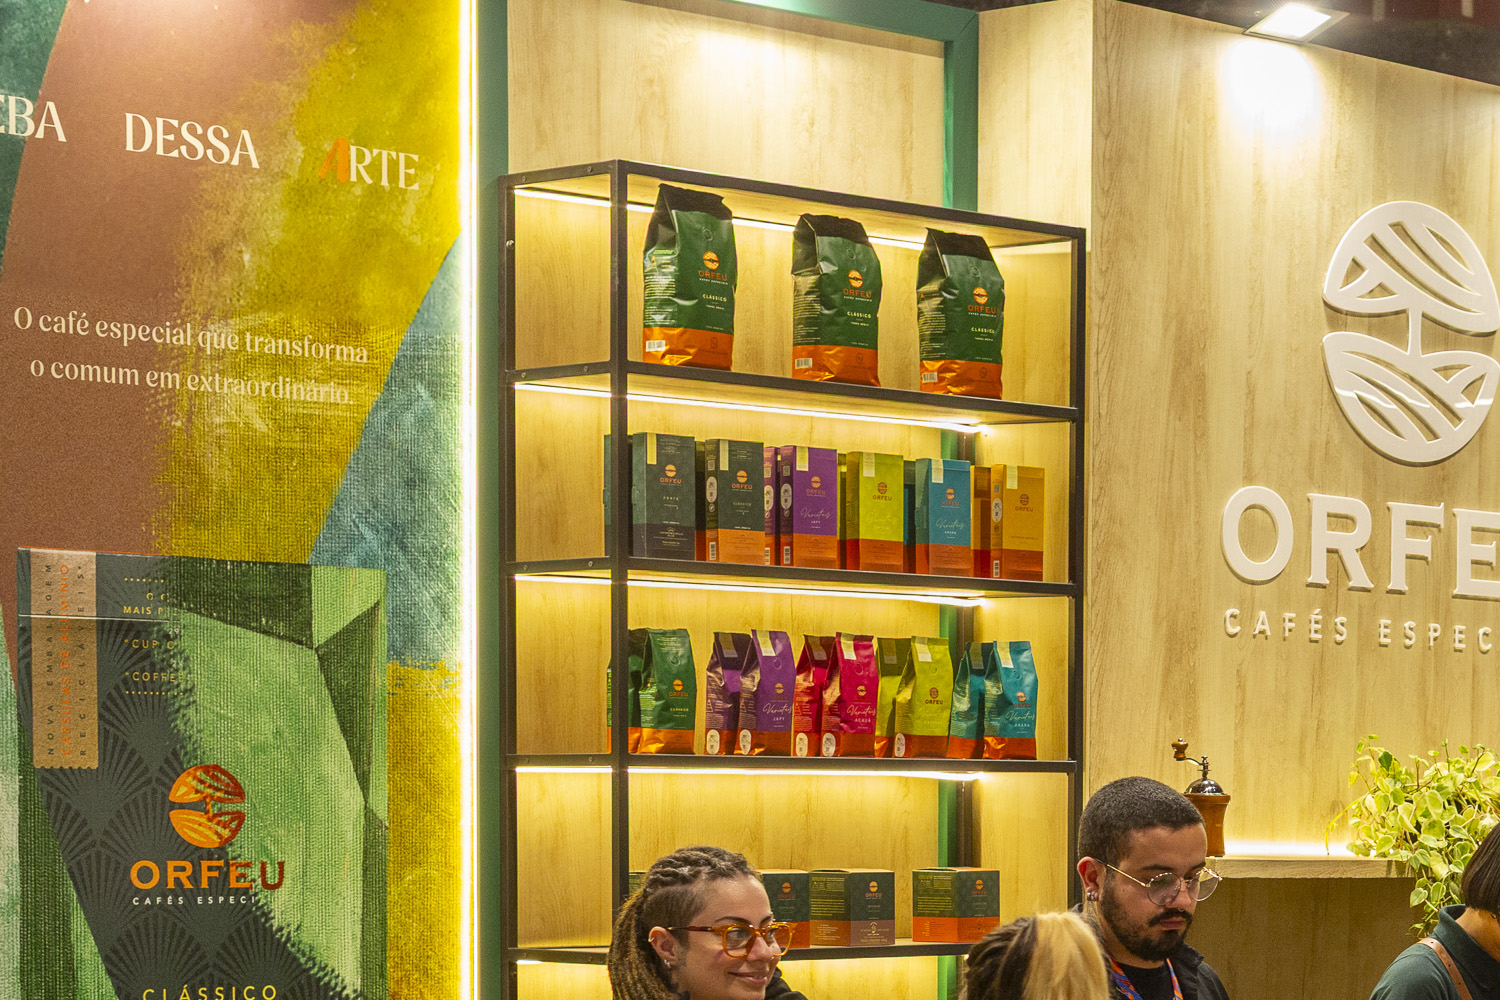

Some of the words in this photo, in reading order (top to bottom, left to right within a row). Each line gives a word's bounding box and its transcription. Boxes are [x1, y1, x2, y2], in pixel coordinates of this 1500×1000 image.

[0, 94, 67, 142] BA
[124, 112, 260, 169] DESSA
[318, 137, 420, 191] ARTE
[698, 270, 728, 281] ORFEU
[843, 288, 872, 298] ORFEU
[968, 304, 996, 314] ORFEU
[13, 306, 33, 330] O
[38, 311, 90, 336] café
[95, 319, 192, 347] especial
[197, 331, 239, 356] que
[245, 332, 369, 363] transforma
[30, 359, 45, 377] o
[50, 362, 139, 386] comum
[145, 371, 181, 390] em
[186, 373, 355, 405] extraordinário.
[123, 606, 152, 614] MAIS
[1224, 608, 1348, 643] CAFÉS
[61, 651, 70, 669] DE
[60, 677, 71, 755] CÁPSULAS
[130, 860, 285, 890] ORFEU
[132, 896, 184, 905] CAFÉS
[198, 896, 255, 904] ESPECI
